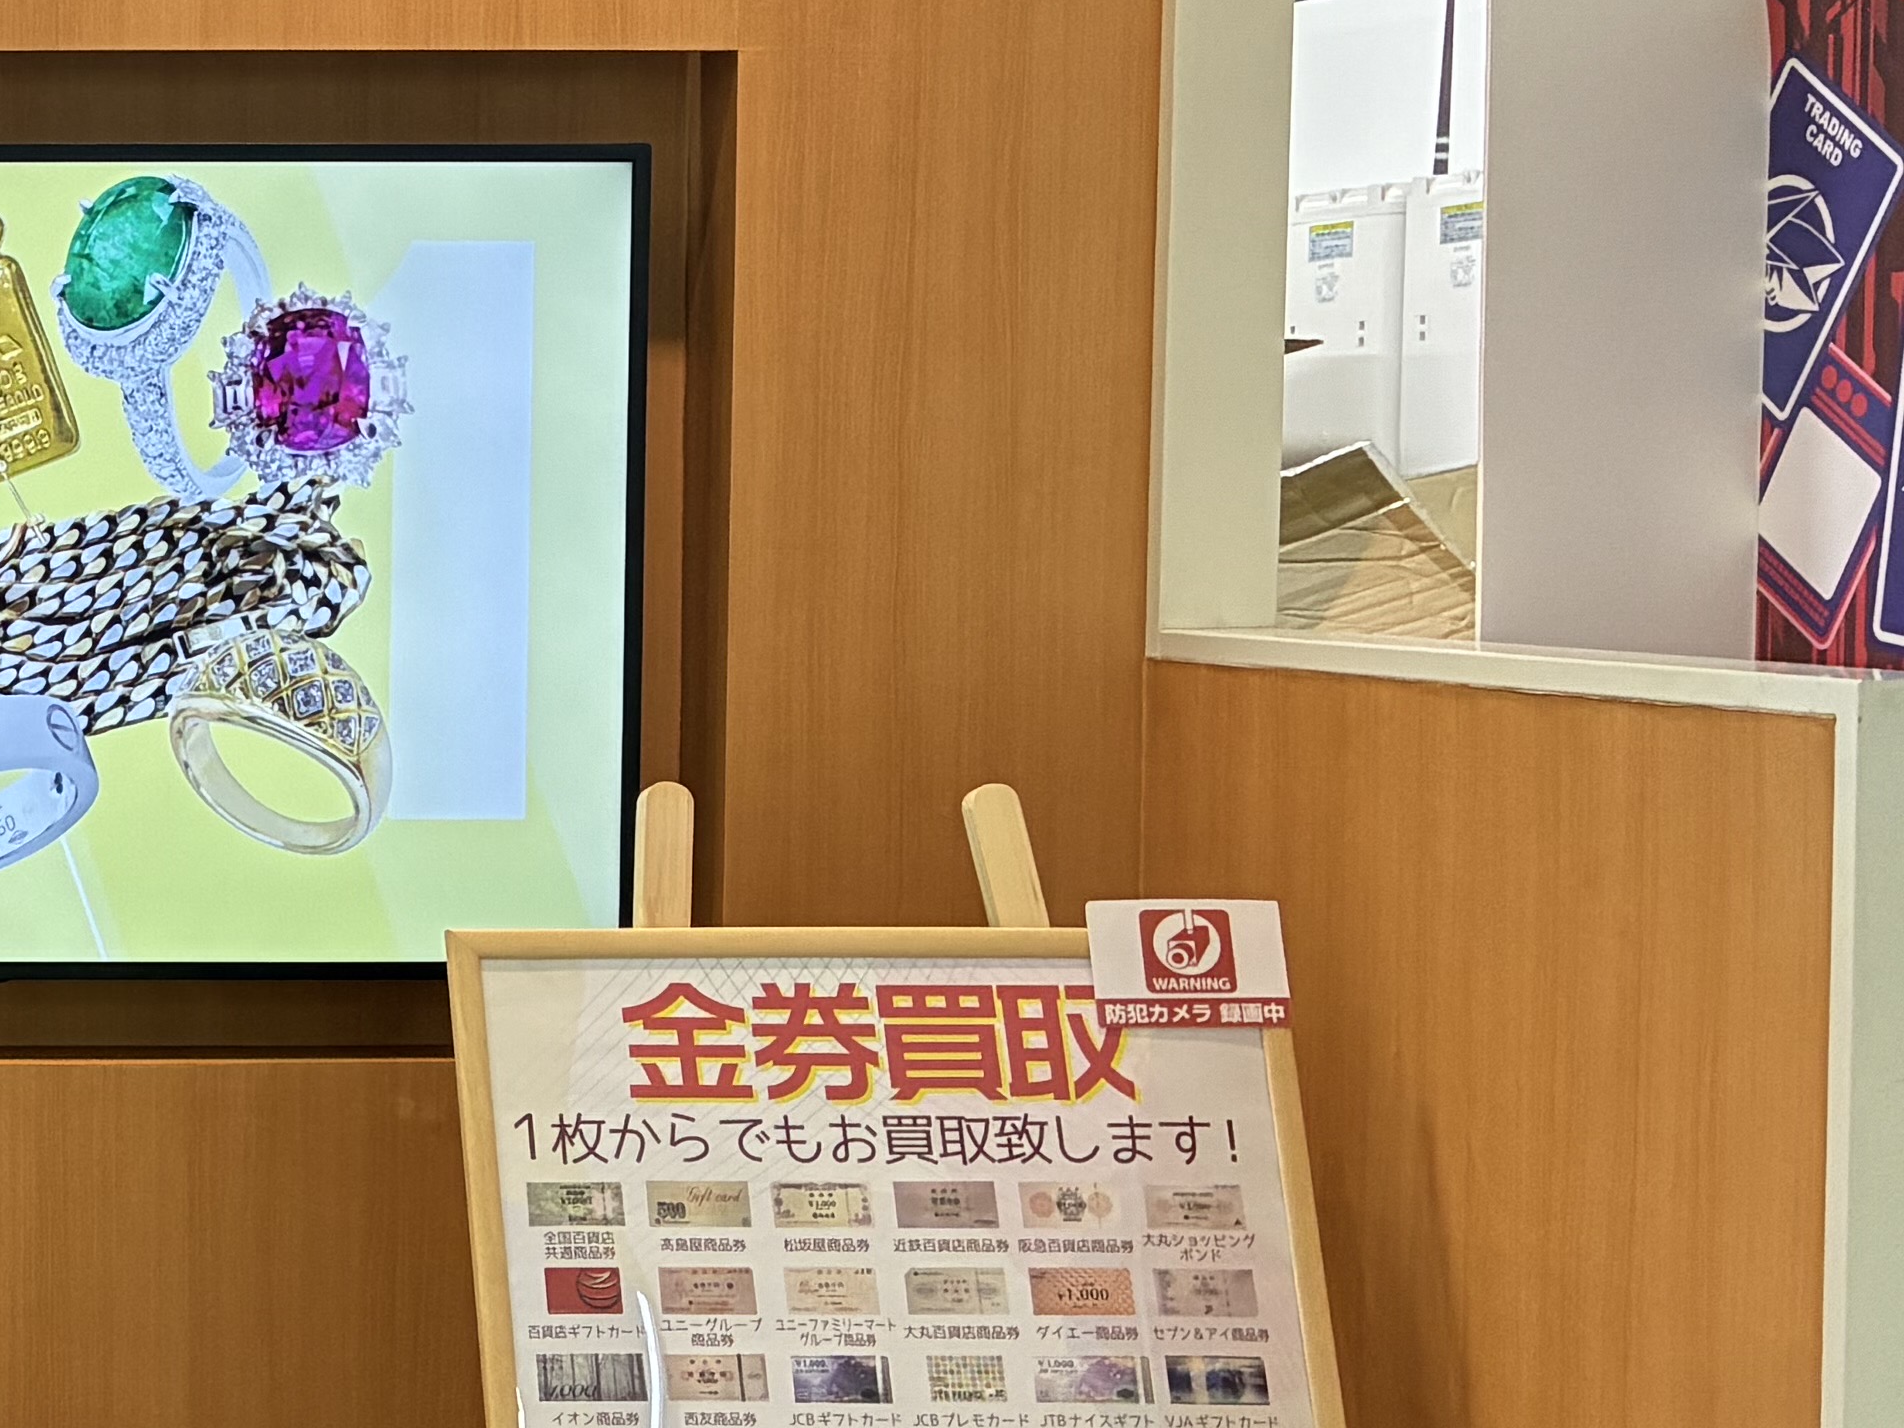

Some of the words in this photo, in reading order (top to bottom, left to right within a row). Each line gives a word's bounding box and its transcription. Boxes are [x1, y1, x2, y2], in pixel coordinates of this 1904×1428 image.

[1804, 92, 1863, 159] TRADING
[1805, 124, 1843, 167] CARD
[1152, 977, 1232, 991] WARNING
[1104, 1003, 1212, 1025] 防犯カメラ
[1219, 1002, 1286, 1024] 録画中
[622, 982, 1140, 1103] 金券買取
[514, 1113, 1240, 1167] 1枚からでもお買取致します！
